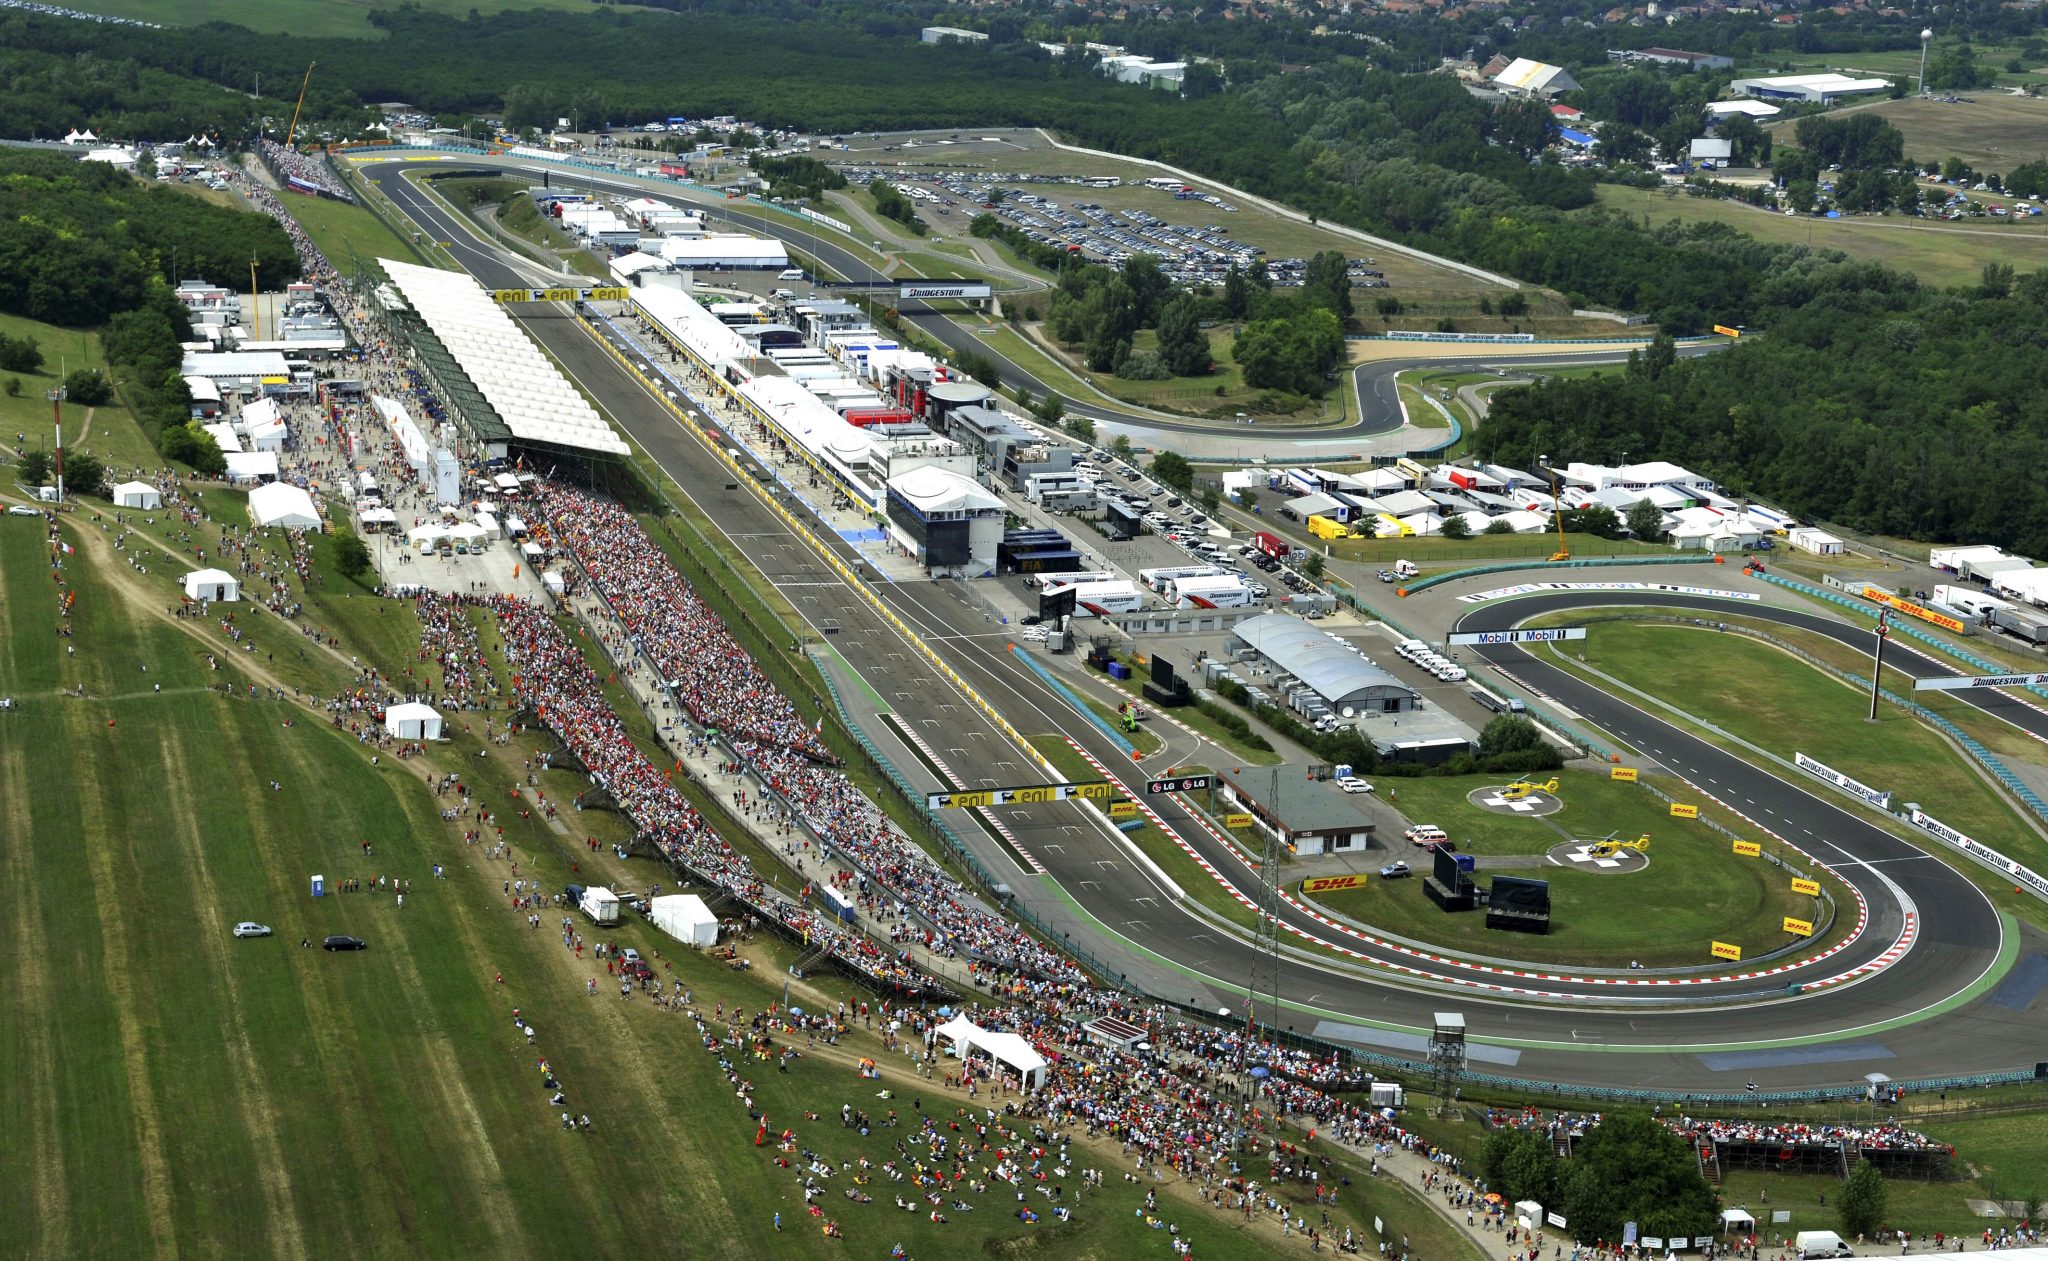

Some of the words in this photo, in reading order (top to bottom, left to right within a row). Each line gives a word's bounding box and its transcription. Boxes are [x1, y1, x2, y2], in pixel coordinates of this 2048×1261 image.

[502, 289, 526, 301] eni
[551, 289, 574, 300] eni
[598, 288, 621, 300] eni
[908, 288, 964, 297] BRIDGESTONE
[1900, 602, 1925, 616] DHL
[1933, 614, 1958, 629] DHL
[1479, 633, 1507, 643] Mobil
[1526, 631, 1554, 641] Mobil
[1972, 677, 2029, 687] BRIDGESTONE
[1800, 756, 1839, 783] BRIDGESTONE
[1164, 782, 1175, 791] LG
[1193, 780, 1205, 788] LG
[958, 793, 985, 807] eni
[1020, 788, 1047, 803] eni
[1084, 783, 1111, 799] eni
[1736, 844, 1758, 852] DHL
[1965, 838, 2012, 870] BRIDGESTONE
[1312, 877, 1358, 891] DHL
[1795, 882, 1816, 891] DHL
[1787, 922, 1808, 932] DHL
[1715, 946, 1737, 956] DHL
